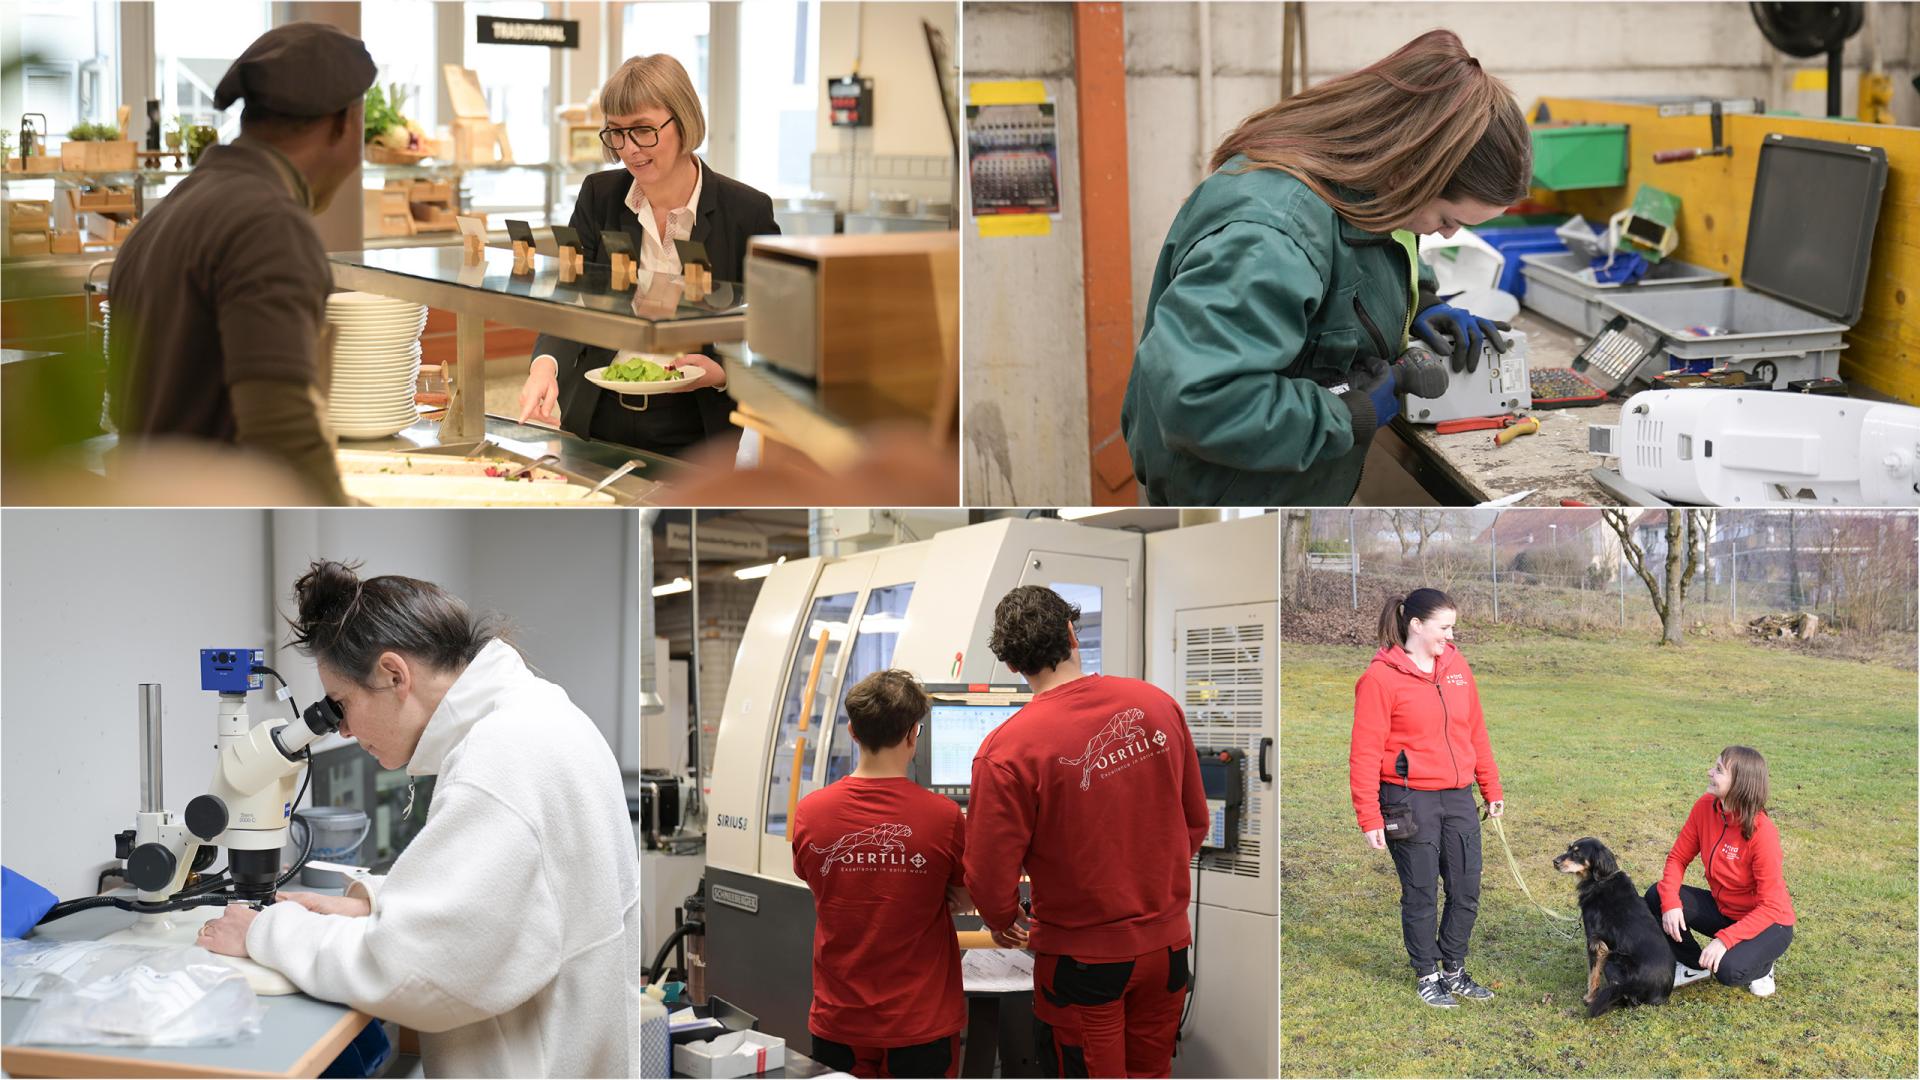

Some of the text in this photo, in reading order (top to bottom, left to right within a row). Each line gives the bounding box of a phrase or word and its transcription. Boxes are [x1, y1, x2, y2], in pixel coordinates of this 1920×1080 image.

[492, 22, 566, 42] TRADITIONAL
[1756, 365, 1773, 384] 18
[1097, 738, 1150, 769] OERTLI
[717, 814, 743, 829] SIRIUS
[840, 852, 906, 865] OERTLI
